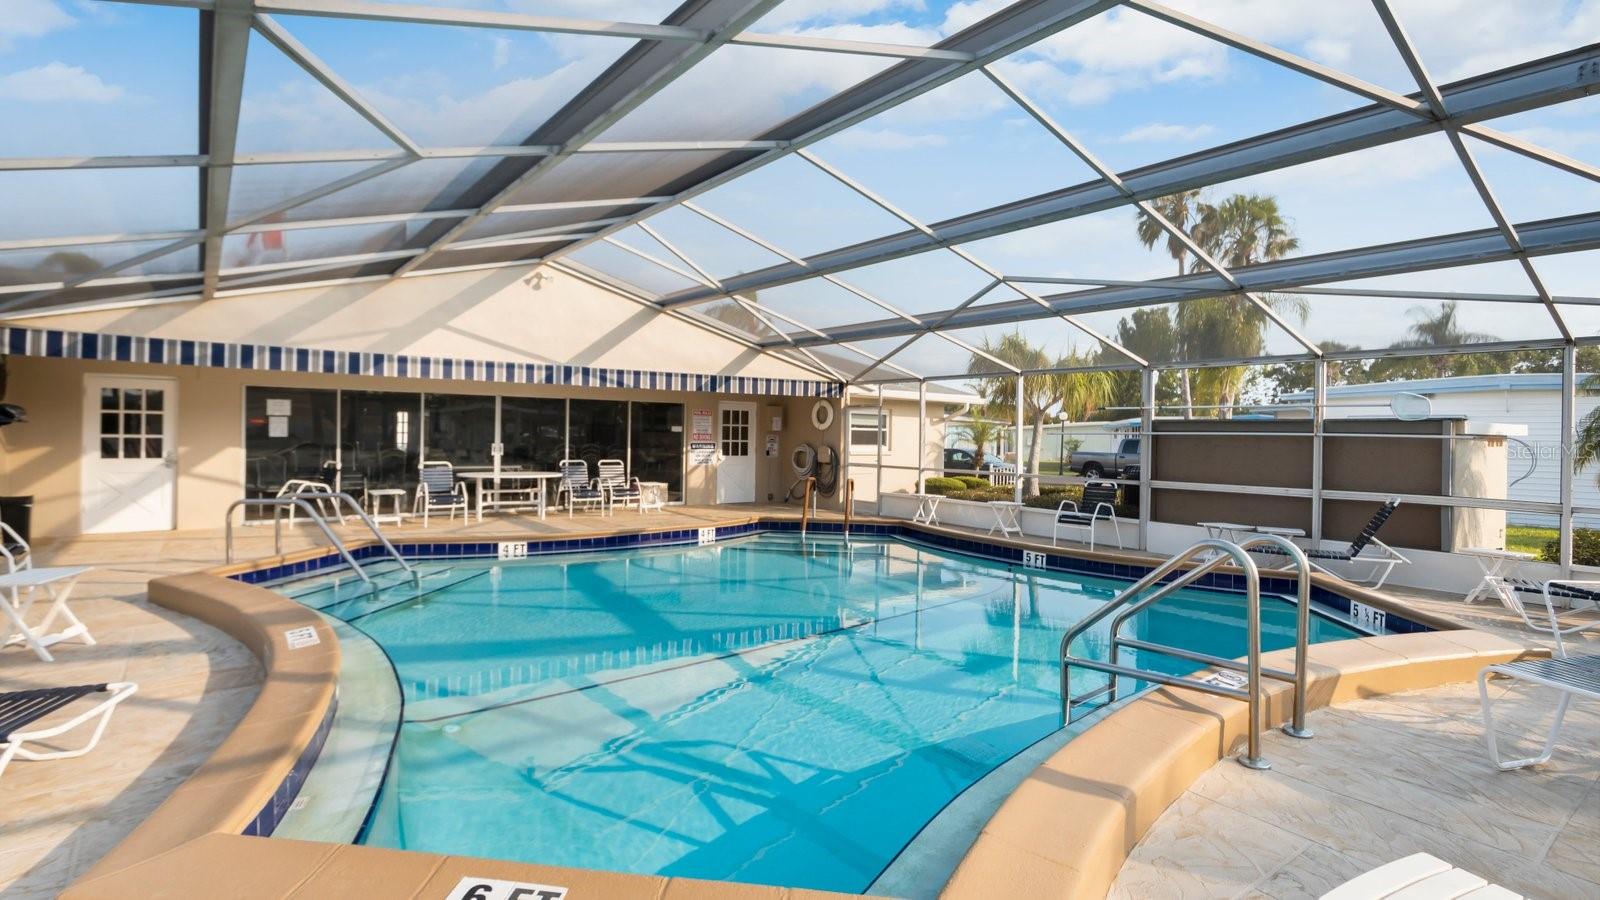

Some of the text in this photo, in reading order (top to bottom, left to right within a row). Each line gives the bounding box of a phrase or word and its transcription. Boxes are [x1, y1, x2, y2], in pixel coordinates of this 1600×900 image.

[514, 544, 525, 553] FT
[1026, 552, 1045, 564] 5 FT
[1353, 603, 1359, 617] 5
[1373, 611, 1385, 626] FT
